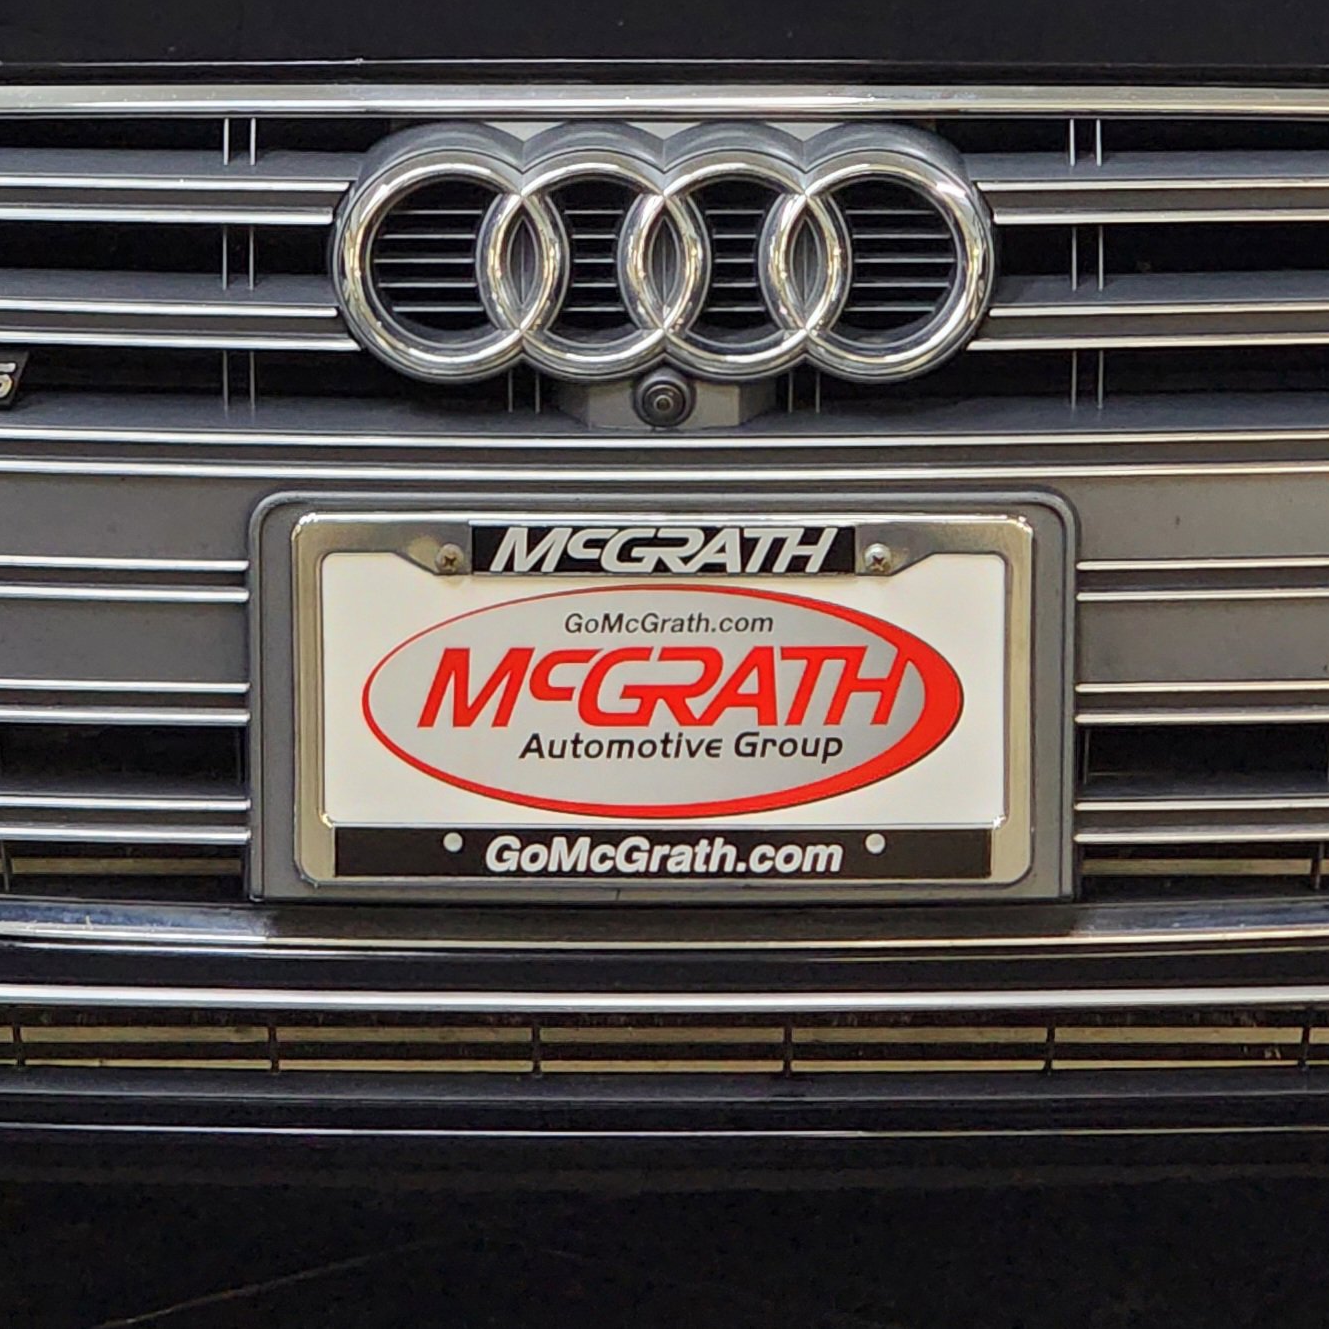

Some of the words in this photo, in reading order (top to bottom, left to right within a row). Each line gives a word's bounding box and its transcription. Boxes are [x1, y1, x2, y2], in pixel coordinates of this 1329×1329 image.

[564, 612, 775, 635] GoMcGrath.com
[518, 732, 723, 760] Automotive
[734, 731, 845, 764] Group
[485, 835, 844, 873] GoMcGrath.com
